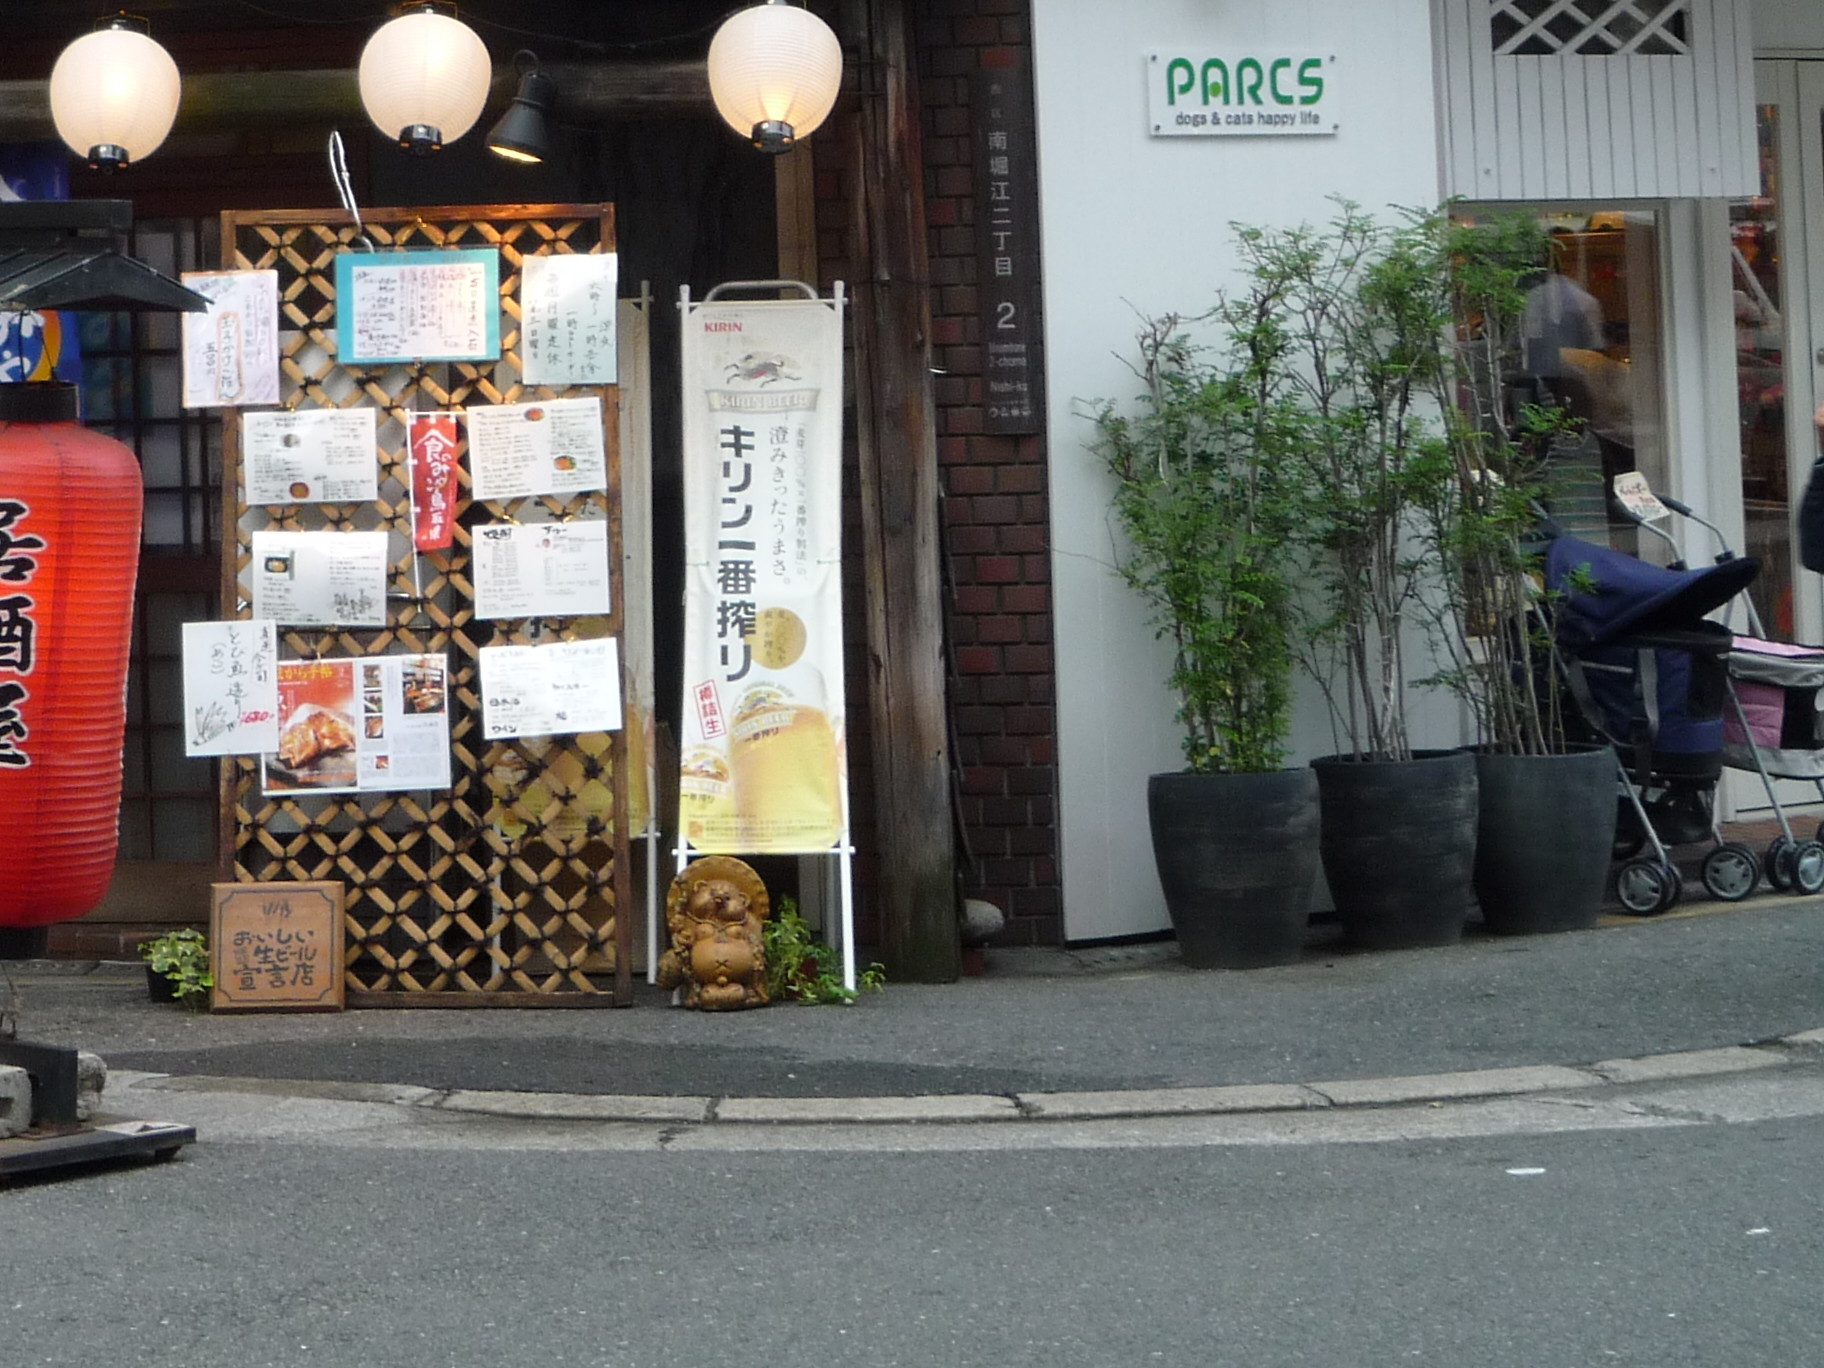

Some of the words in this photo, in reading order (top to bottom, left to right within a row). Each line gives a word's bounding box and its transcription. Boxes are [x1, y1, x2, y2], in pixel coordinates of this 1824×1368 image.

[1166, 57, 1324, 106] PARCS
[1176, 111, 1207, 126] dogs
[1212, 112, 1221, 125] &
[1226, 113, 1253, 125] cats
[1257, 111, 1296, 126] happy
[1300, 111, 1320, 125] life
[988, 132, 1013, 276] 南堀江二丁目
[704, 322, 743, 332] KIRIN
[997, 302, 1016, 329] 2
[717, 425, 757, 682] キリン一番搾り
[234, 928, 314, 946] おいしい
[254, 945, 317, 964] 生ビール
